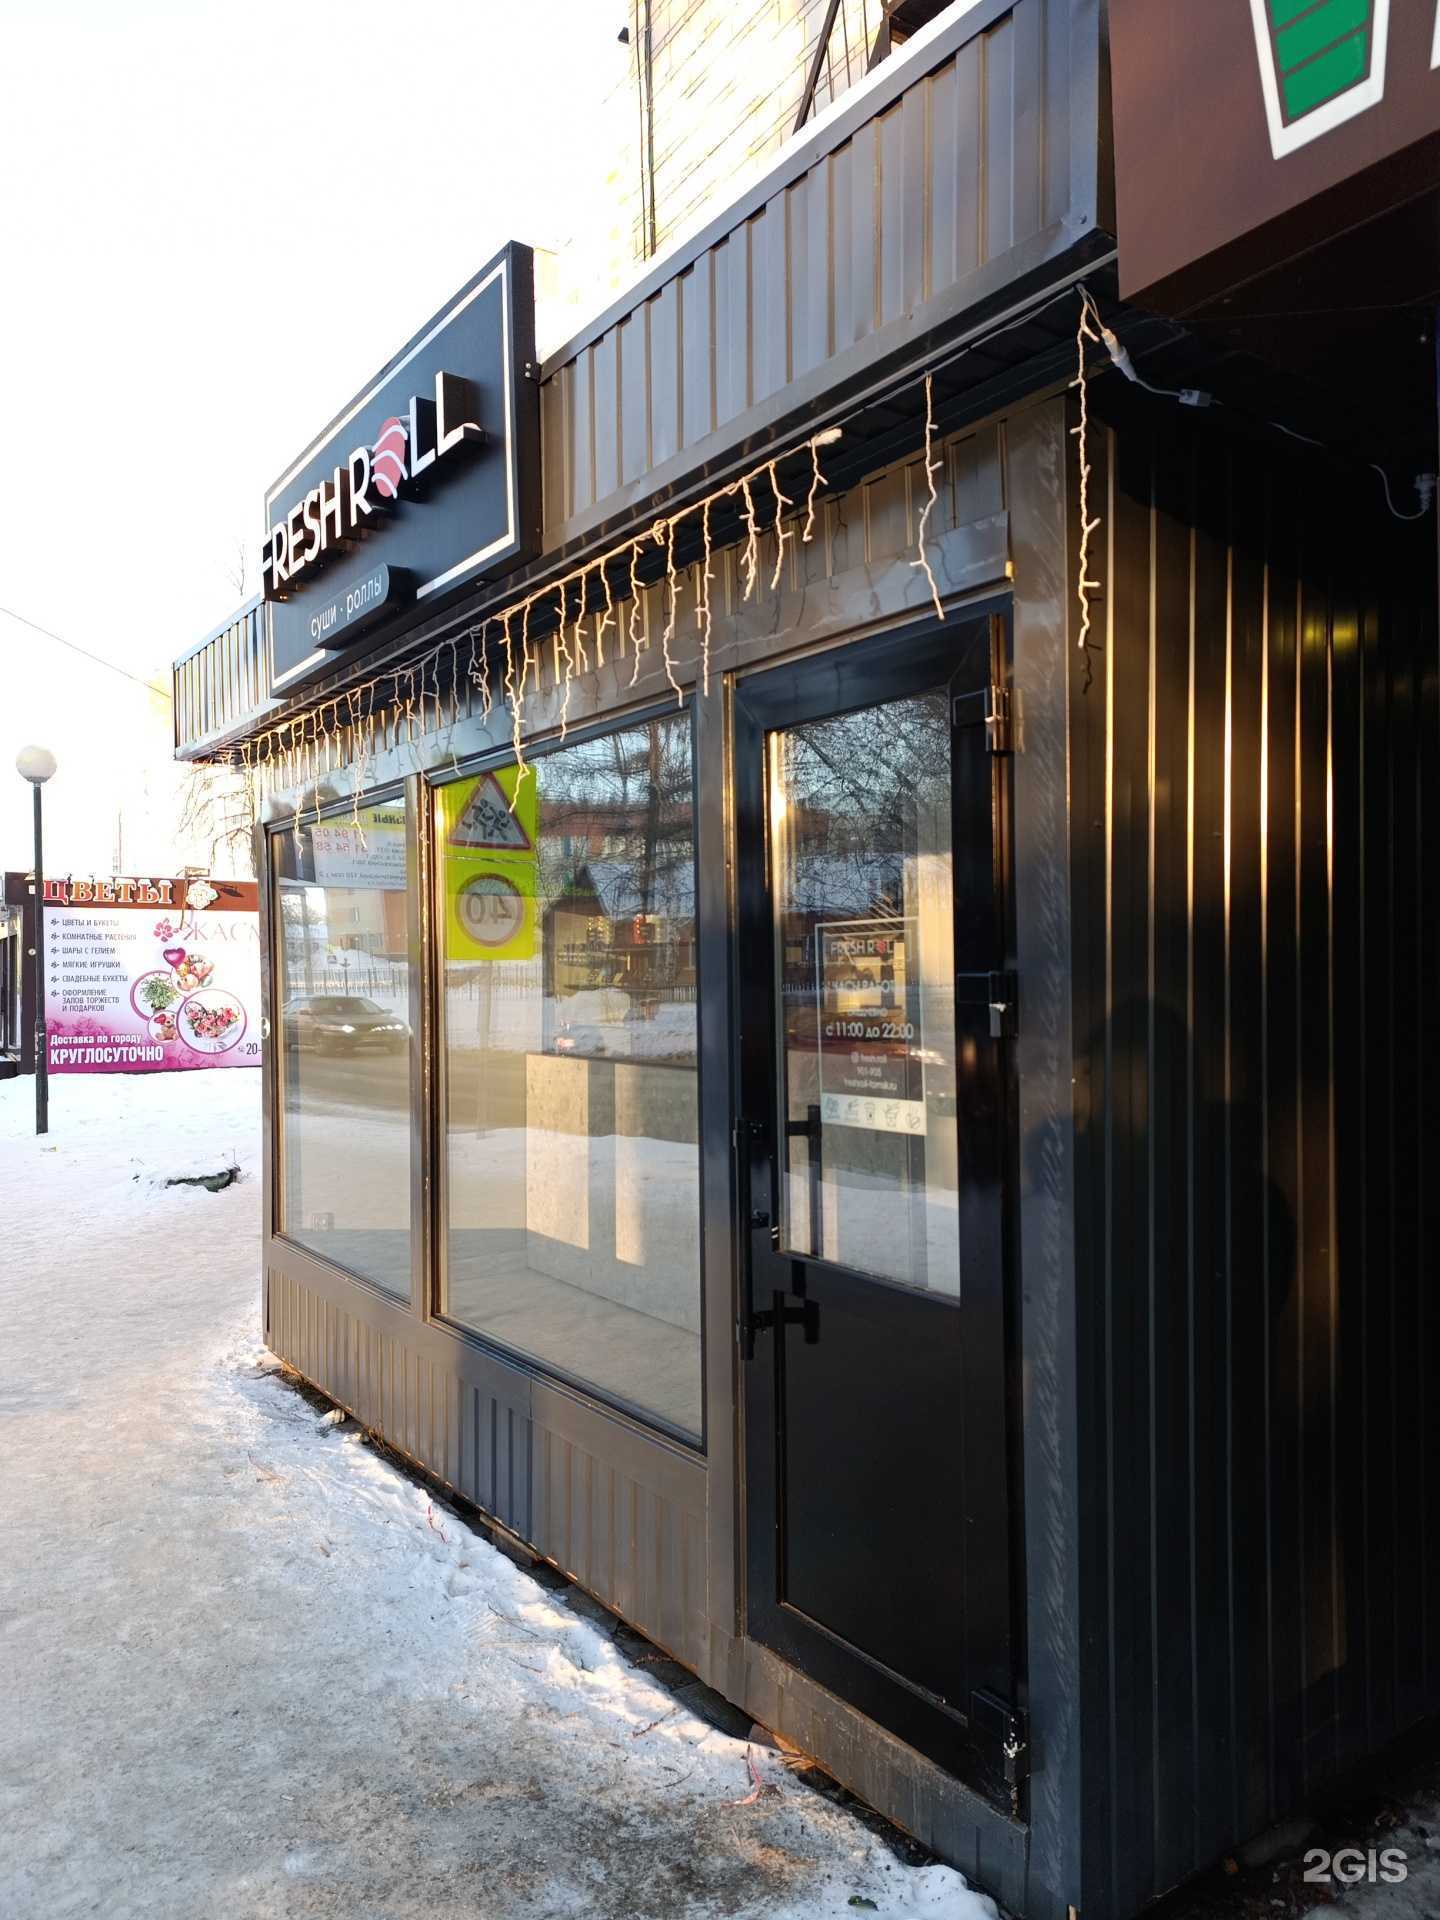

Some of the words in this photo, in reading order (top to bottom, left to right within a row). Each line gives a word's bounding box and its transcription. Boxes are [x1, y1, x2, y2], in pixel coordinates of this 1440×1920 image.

[259, 467, 342, 590] FRESH
[310, 609, 337, 640] суши
[346, 574, 383, 619] роллы
[43, 879, 174, 905] ЦВЕТЫ
[62, 918, 85, 927] ЦВЕТЫ
[93, 919, 119, 927] БУКЕТЫ
[62, 933, 102, 941] КОМНАТНЫЕ
[62, 975, 100, 983] СВАДЕБНЫЕ
[69, 1005, 105, 1013] ПОДАРКОВ
[836, 1022, 864, 1037] 11:00
[50, 1034, 94, 1046] Доставка
[97, 1036, 108, 1044] по
[111, 1033, 142, 1046] городу
[50, 1046, 164, 1065] КРУГЛОСУТОЧНО
